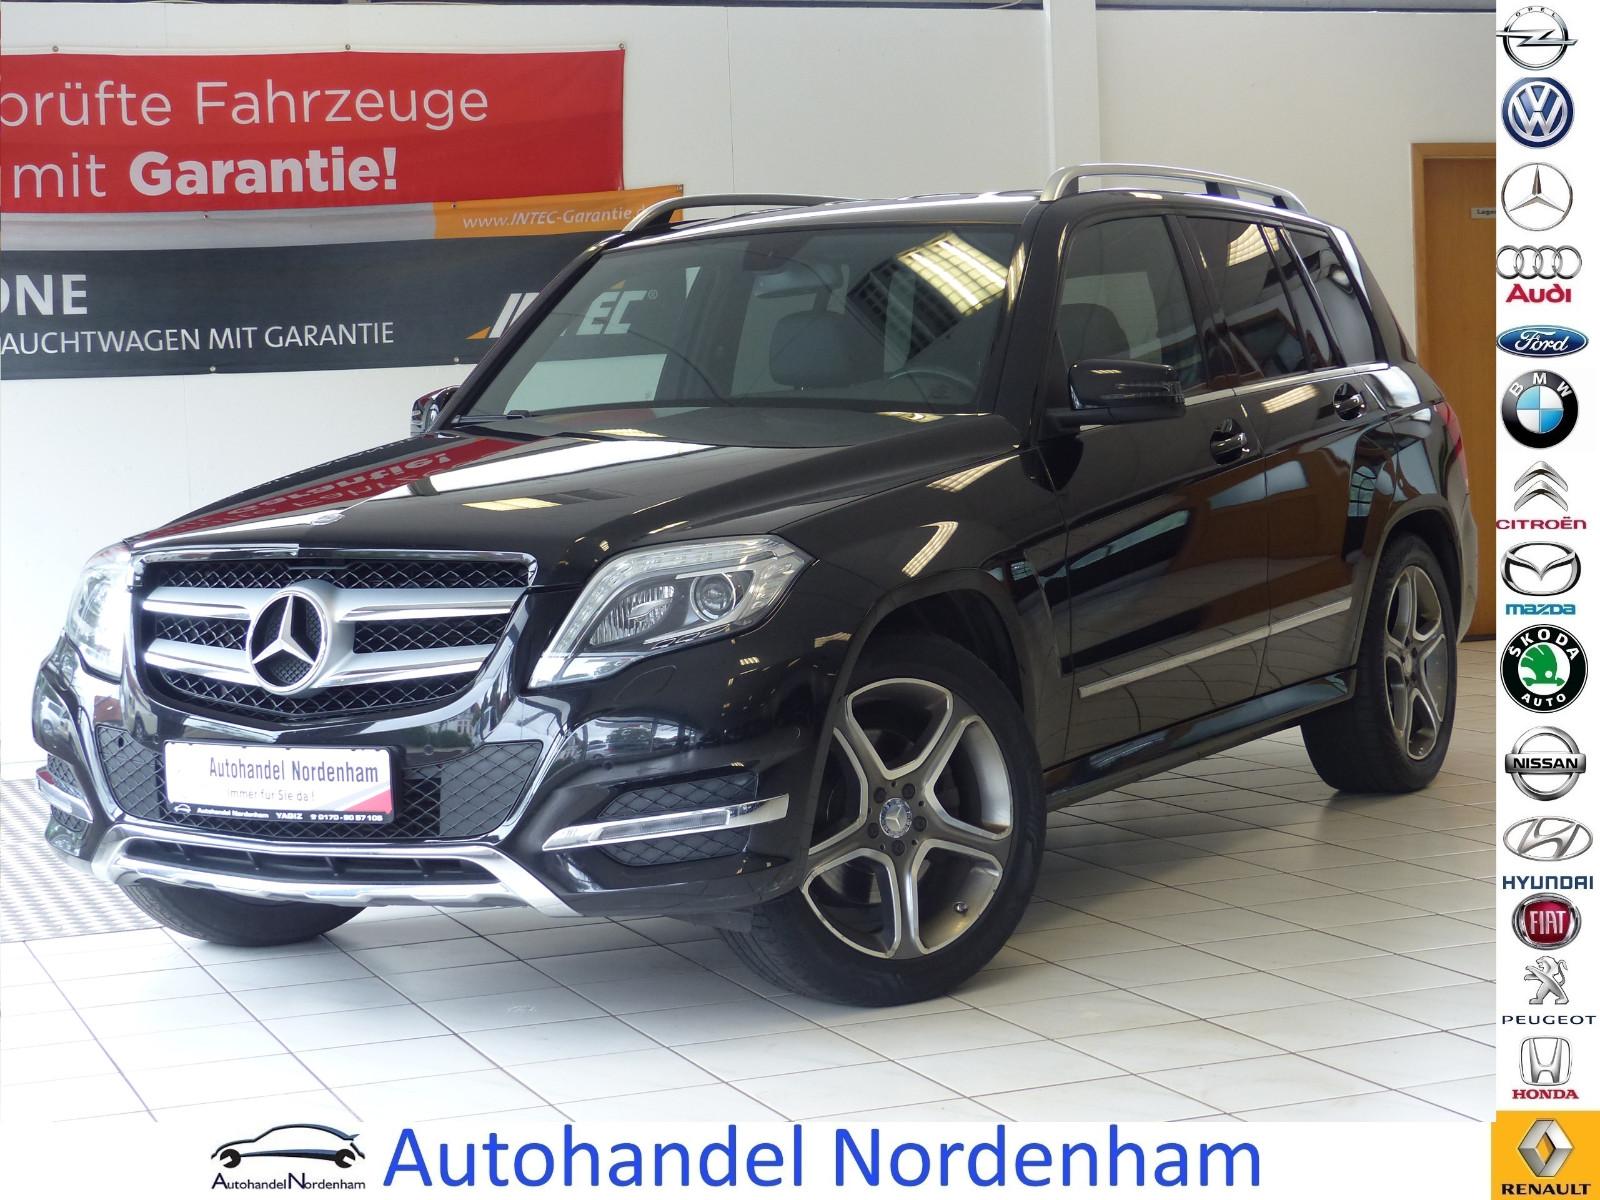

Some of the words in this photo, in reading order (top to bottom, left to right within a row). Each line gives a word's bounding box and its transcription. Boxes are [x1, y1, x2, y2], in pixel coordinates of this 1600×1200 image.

[196, 78, 488, 130] Fahrzeuge
[13, 152, 107, 199] mit
[129, 145, 397, 197] Garantie!
[0, 273, 89, 316] NE
[208, 327, 257, 350] MIT
[264, 321, 395, 348] GARANTIE
[209, 757, 285, 781] Autohandel
[291, 760, 379, 783] Nordenham
[278, 789, 294, 801] Sie
